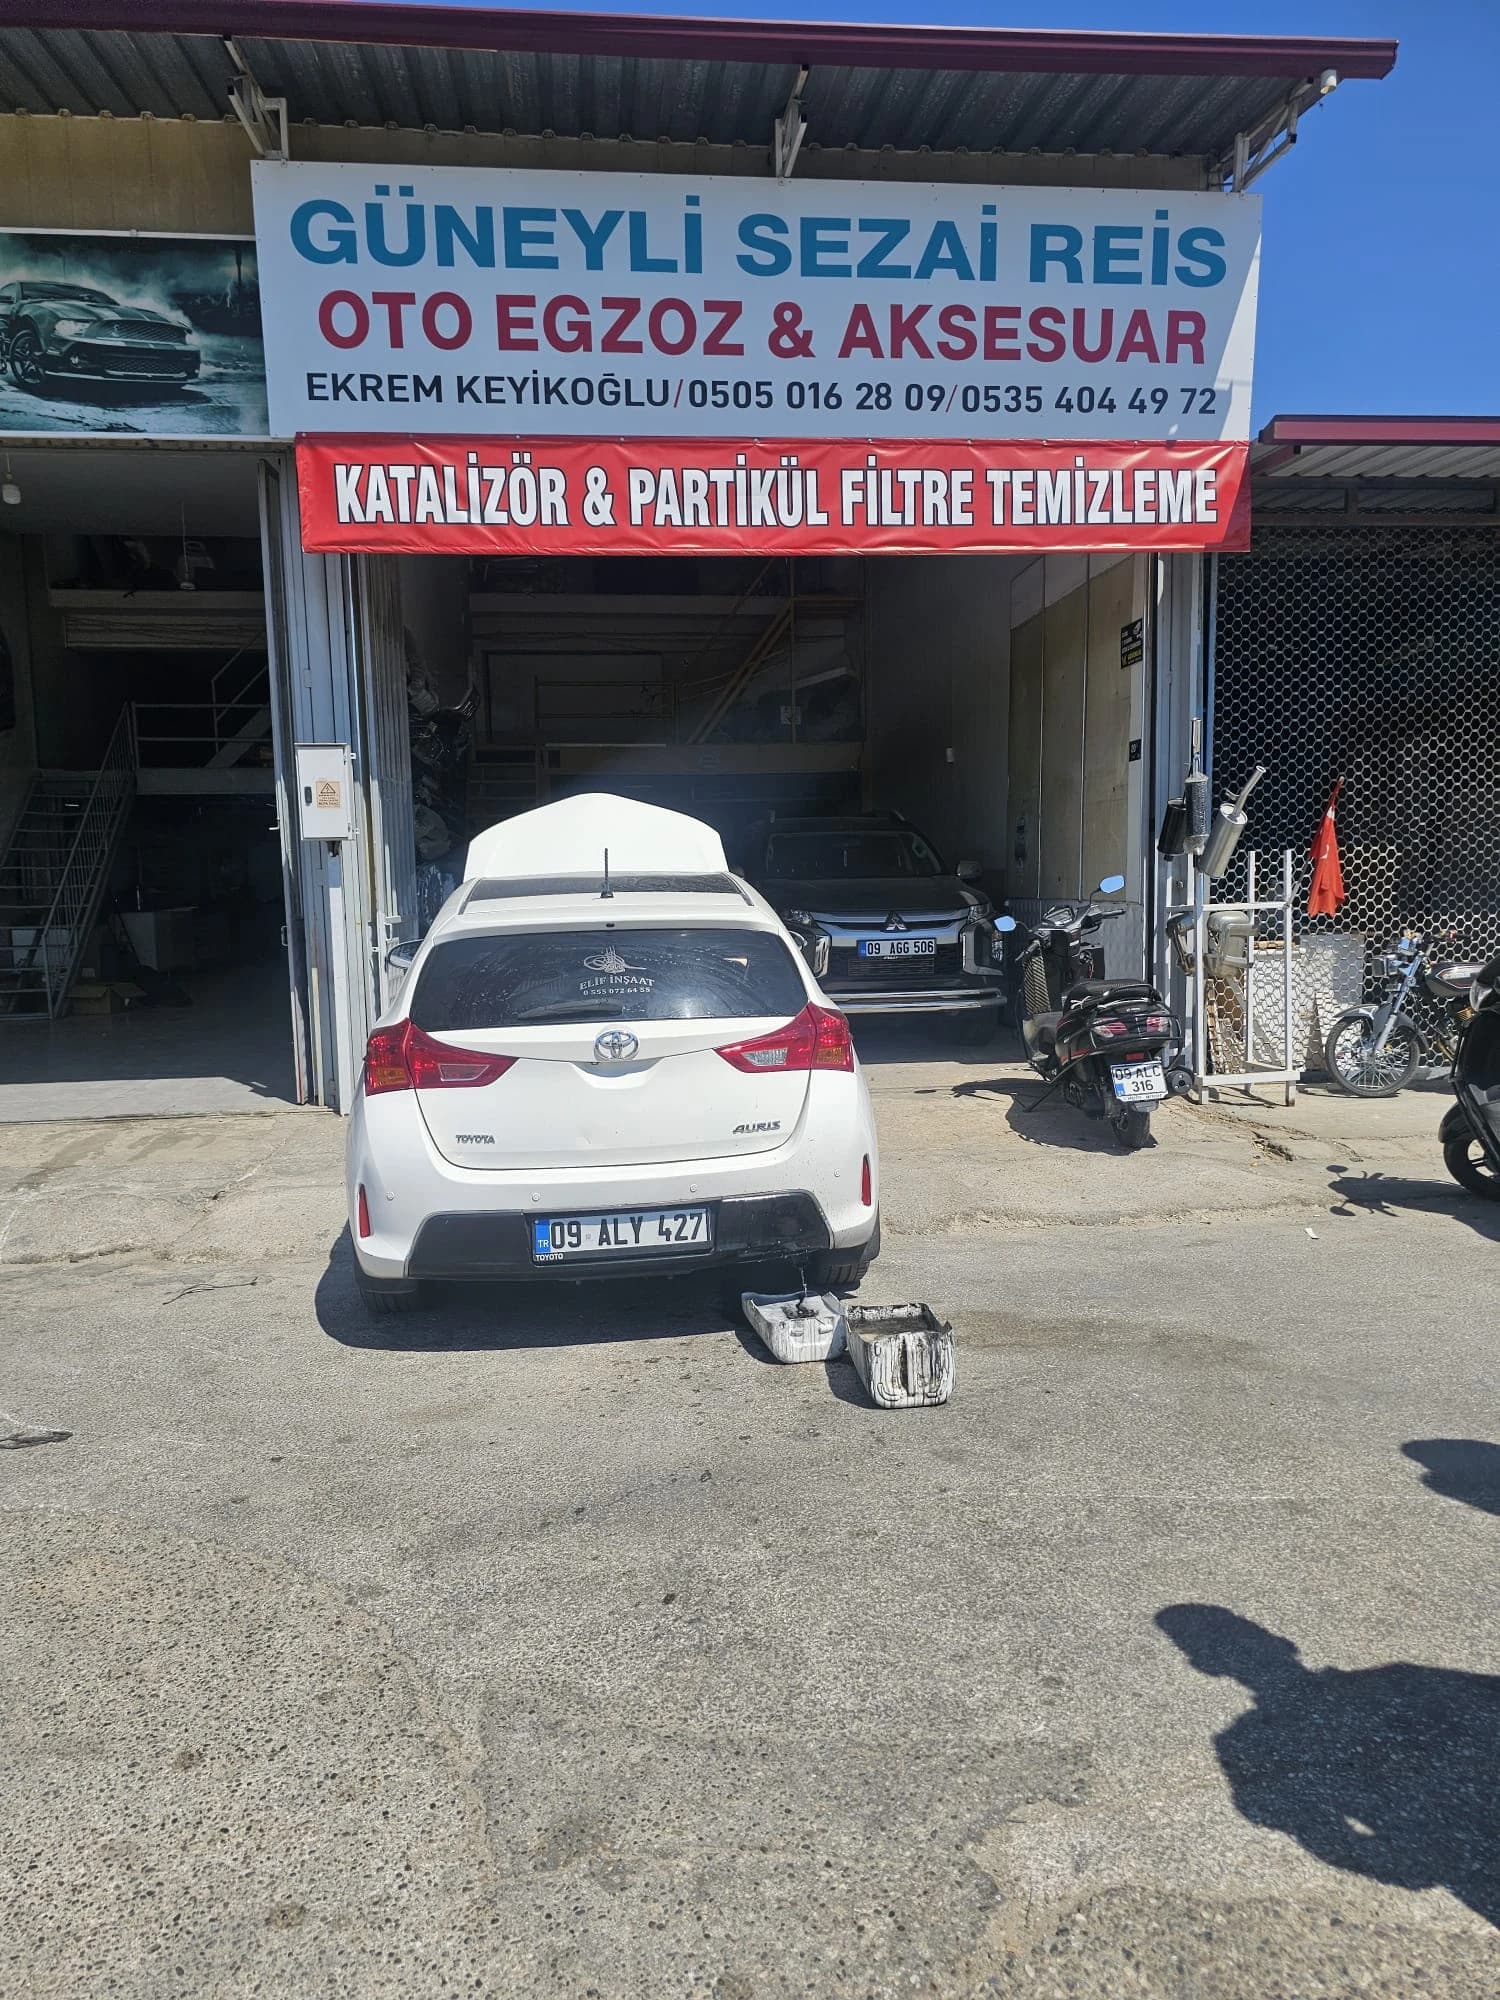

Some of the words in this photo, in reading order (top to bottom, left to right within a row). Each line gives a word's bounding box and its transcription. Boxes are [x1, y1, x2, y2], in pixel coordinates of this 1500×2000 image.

[290, 184, 703, 274] GÜNEYLİ
[736, 204, 997, 281] SEZAİ
[1029, 209, 1227, 288] REİS
[318, 290, 473, 351] OTO
[496, 294, 745, 356] EGZOZ
[767, 301, 816, 359] &
[837, 303, 1206, 364] AKSESUAR
[306, 372, 443, 404] EKREM
[786, 381, 842, 410] 016
[855, 382, 892, 411] 28
[1054, 386, 1116, 414] 404
[1127, 387, 1168, 414] 49
[1180, 388, 1216, 414] 72
[333, 451, 570, 527] KATALİZÖR
[582, 466, 616, 527] &
[628, 453, 829, 528] PARTİKÜL
[840, 454, 974, 527] FİLTRE
[985, 455, 1218, 526] TEMİZLEME
[867, 942, 880, 955] 09
[889, 941, 910, 955] AGG
[913, 940, 934, 953] 506
[609, 974, 655, 987] İNŞAAT
[1115, 1067, 1131, 1081] 09
[1136, 1065, 1161, 1079] ALC
[1131, 1079, 1154, 1093] 316
[732, 1120, 781, 1135] AURIS
[455, 1134, 496, 1145] TOYOTA
[551, 1220, 582, 1249] 09
[598, 1216, 643, 1247] ALY
[658, 1212, 703, 1242] 427
[537, 1239, 550, 1249] TR
